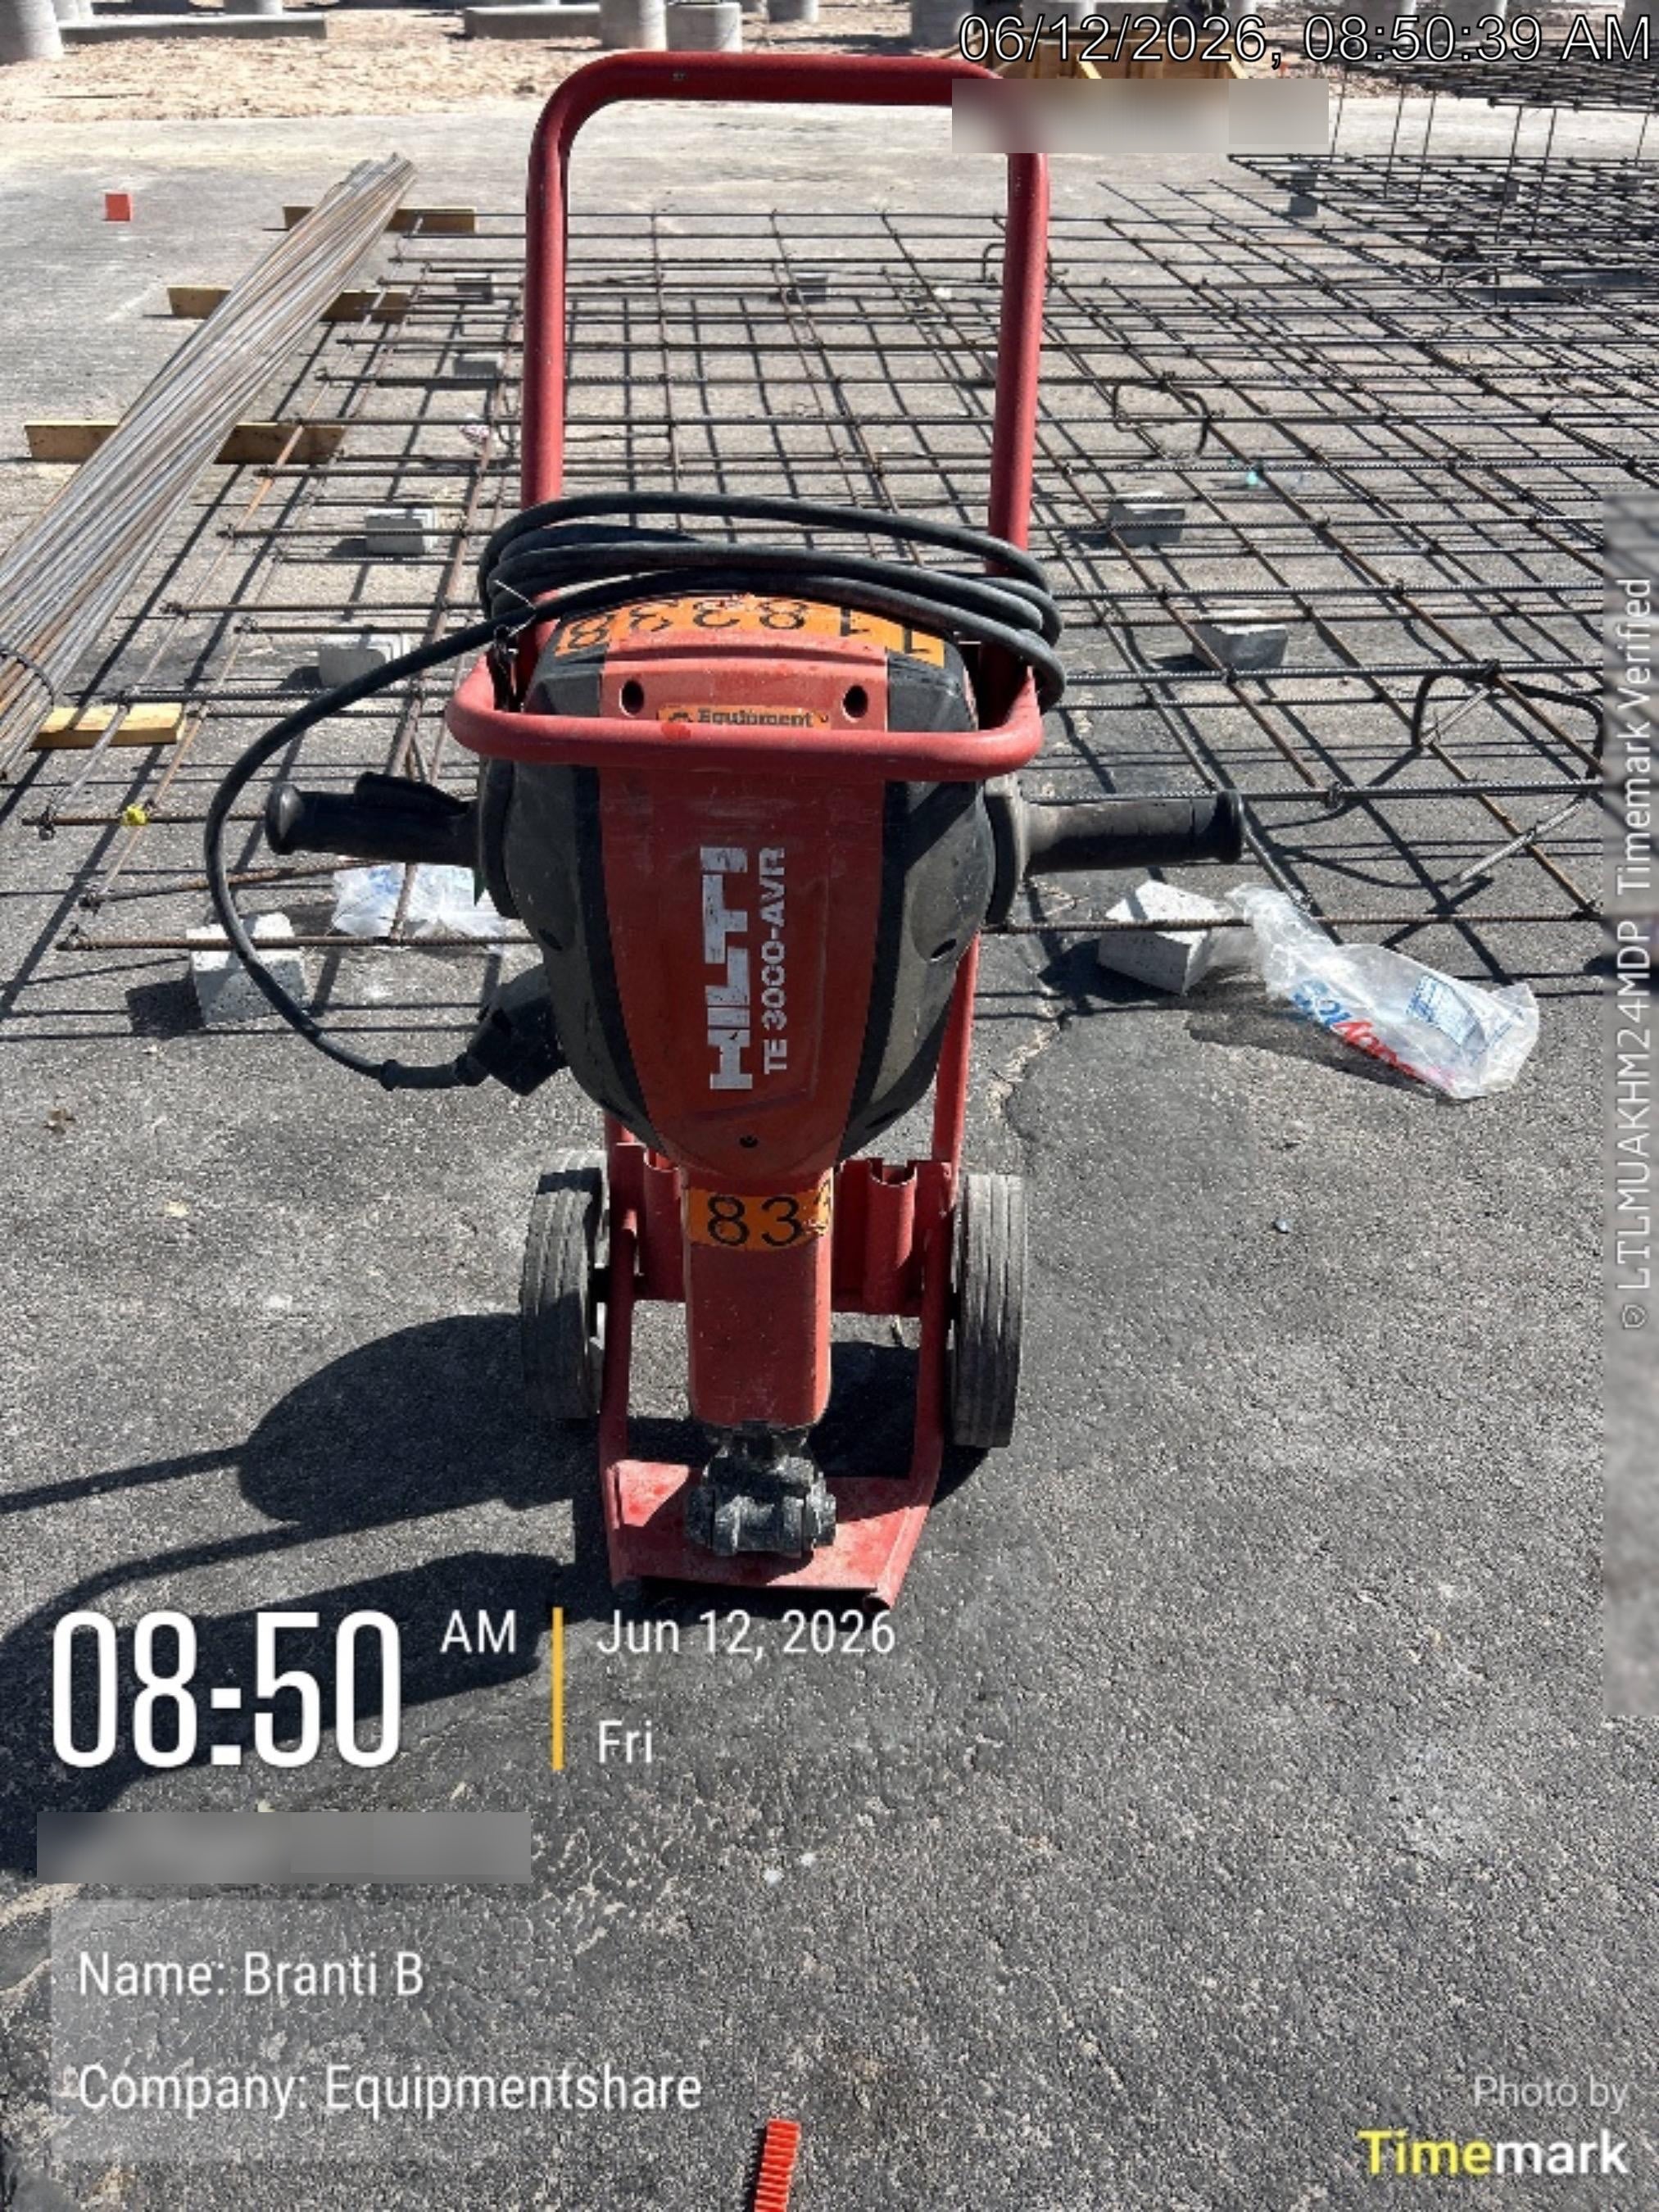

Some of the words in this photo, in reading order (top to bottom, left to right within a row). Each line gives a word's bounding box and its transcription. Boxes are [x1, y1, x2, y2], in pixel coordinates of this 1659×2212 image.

[700, 847, 752, 1090] HILTI
[759, 847, 787, 1031] 3000-AVR
[763, 1040, 788, 1075] TE
